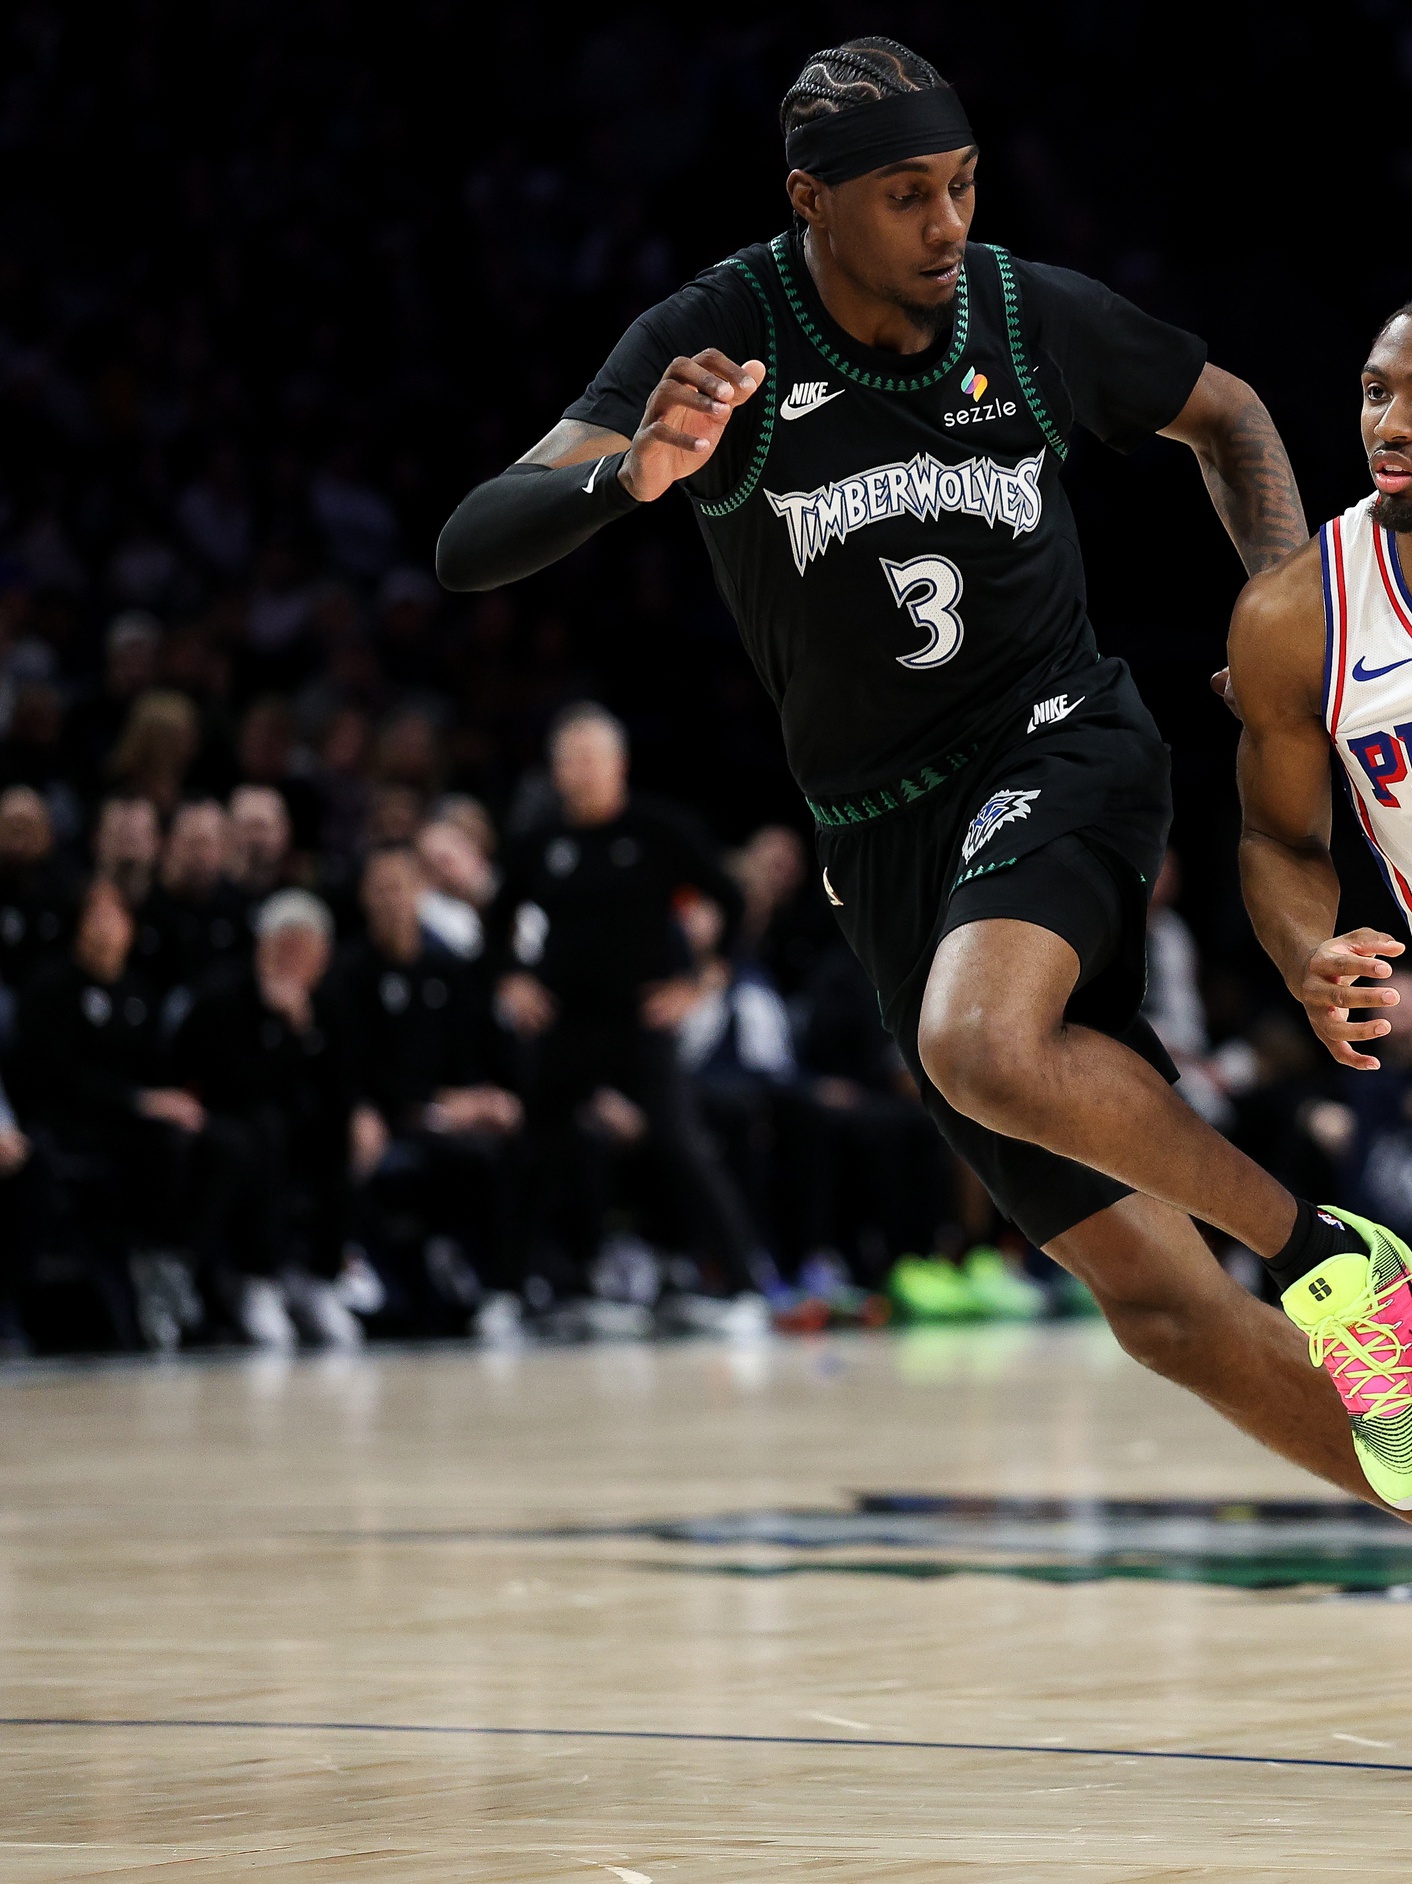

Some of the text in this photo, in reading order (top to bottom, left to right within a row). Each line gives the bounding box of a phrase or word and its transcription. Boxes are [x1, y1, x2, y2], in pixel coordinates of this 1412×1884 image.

[789, 382, 828, 405] NIKE
[944, 397, 1016, 427] sezzle
[879, 554, 964, 669] 3
[1033, 693, 1068, 725] NIKE
